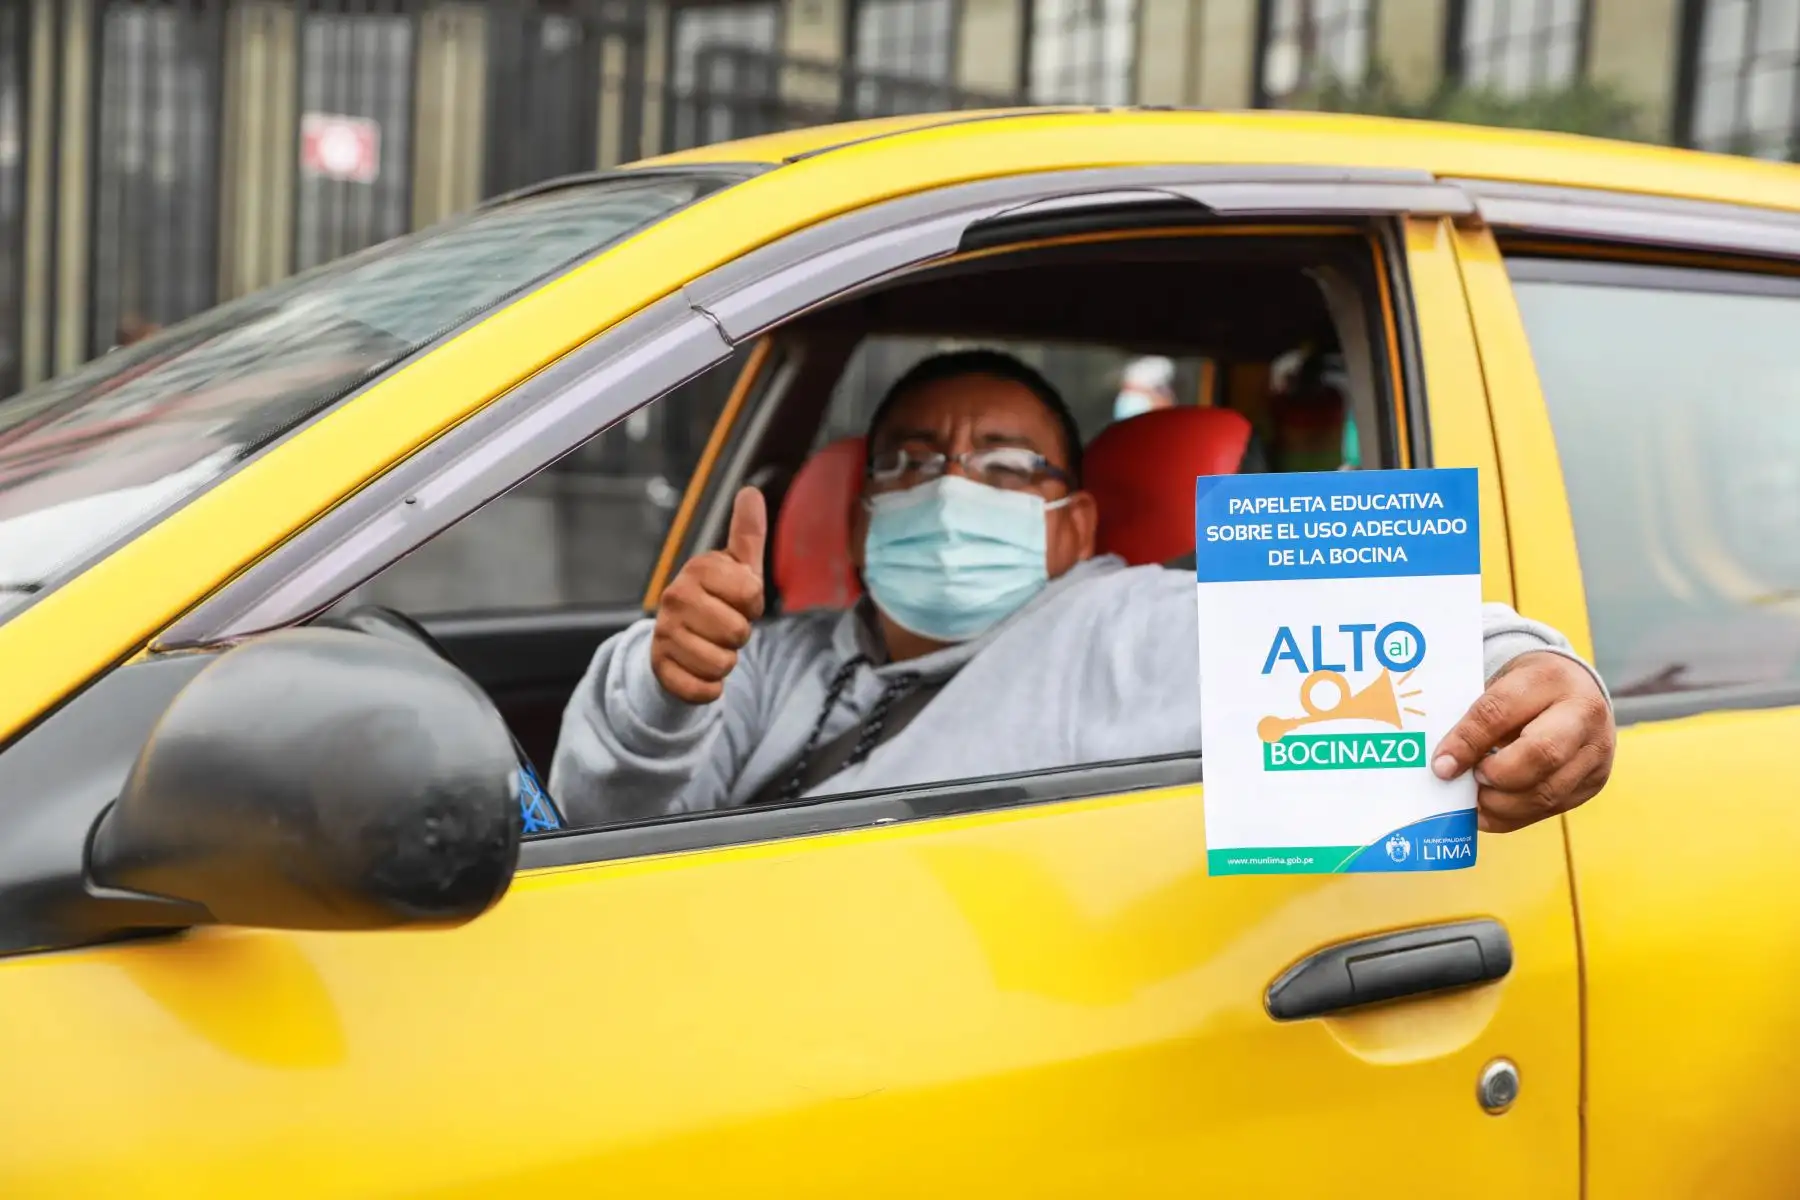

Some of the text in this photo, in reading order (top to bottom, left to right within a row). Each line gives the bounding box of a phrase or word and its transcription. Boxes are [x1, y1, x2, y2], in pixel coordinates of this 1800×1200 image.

[1229, 493, 1444, 514] PAPELETA EDUCATIVA
[1206, 518, 1467, 541] SOBRE EL USO ADECUADO
[1268, 546, 1408, 566] DE LA BOCINA
[1261, 621, 1426, 674] ALTO
[1389, 636, 1409, 656] al
[1271, 739, 1420, 765] BOCINAZO
[1227, 857, 1314, 866] www.munlima.gob.pe
[1423, 843, 1471, 860] LIMA
